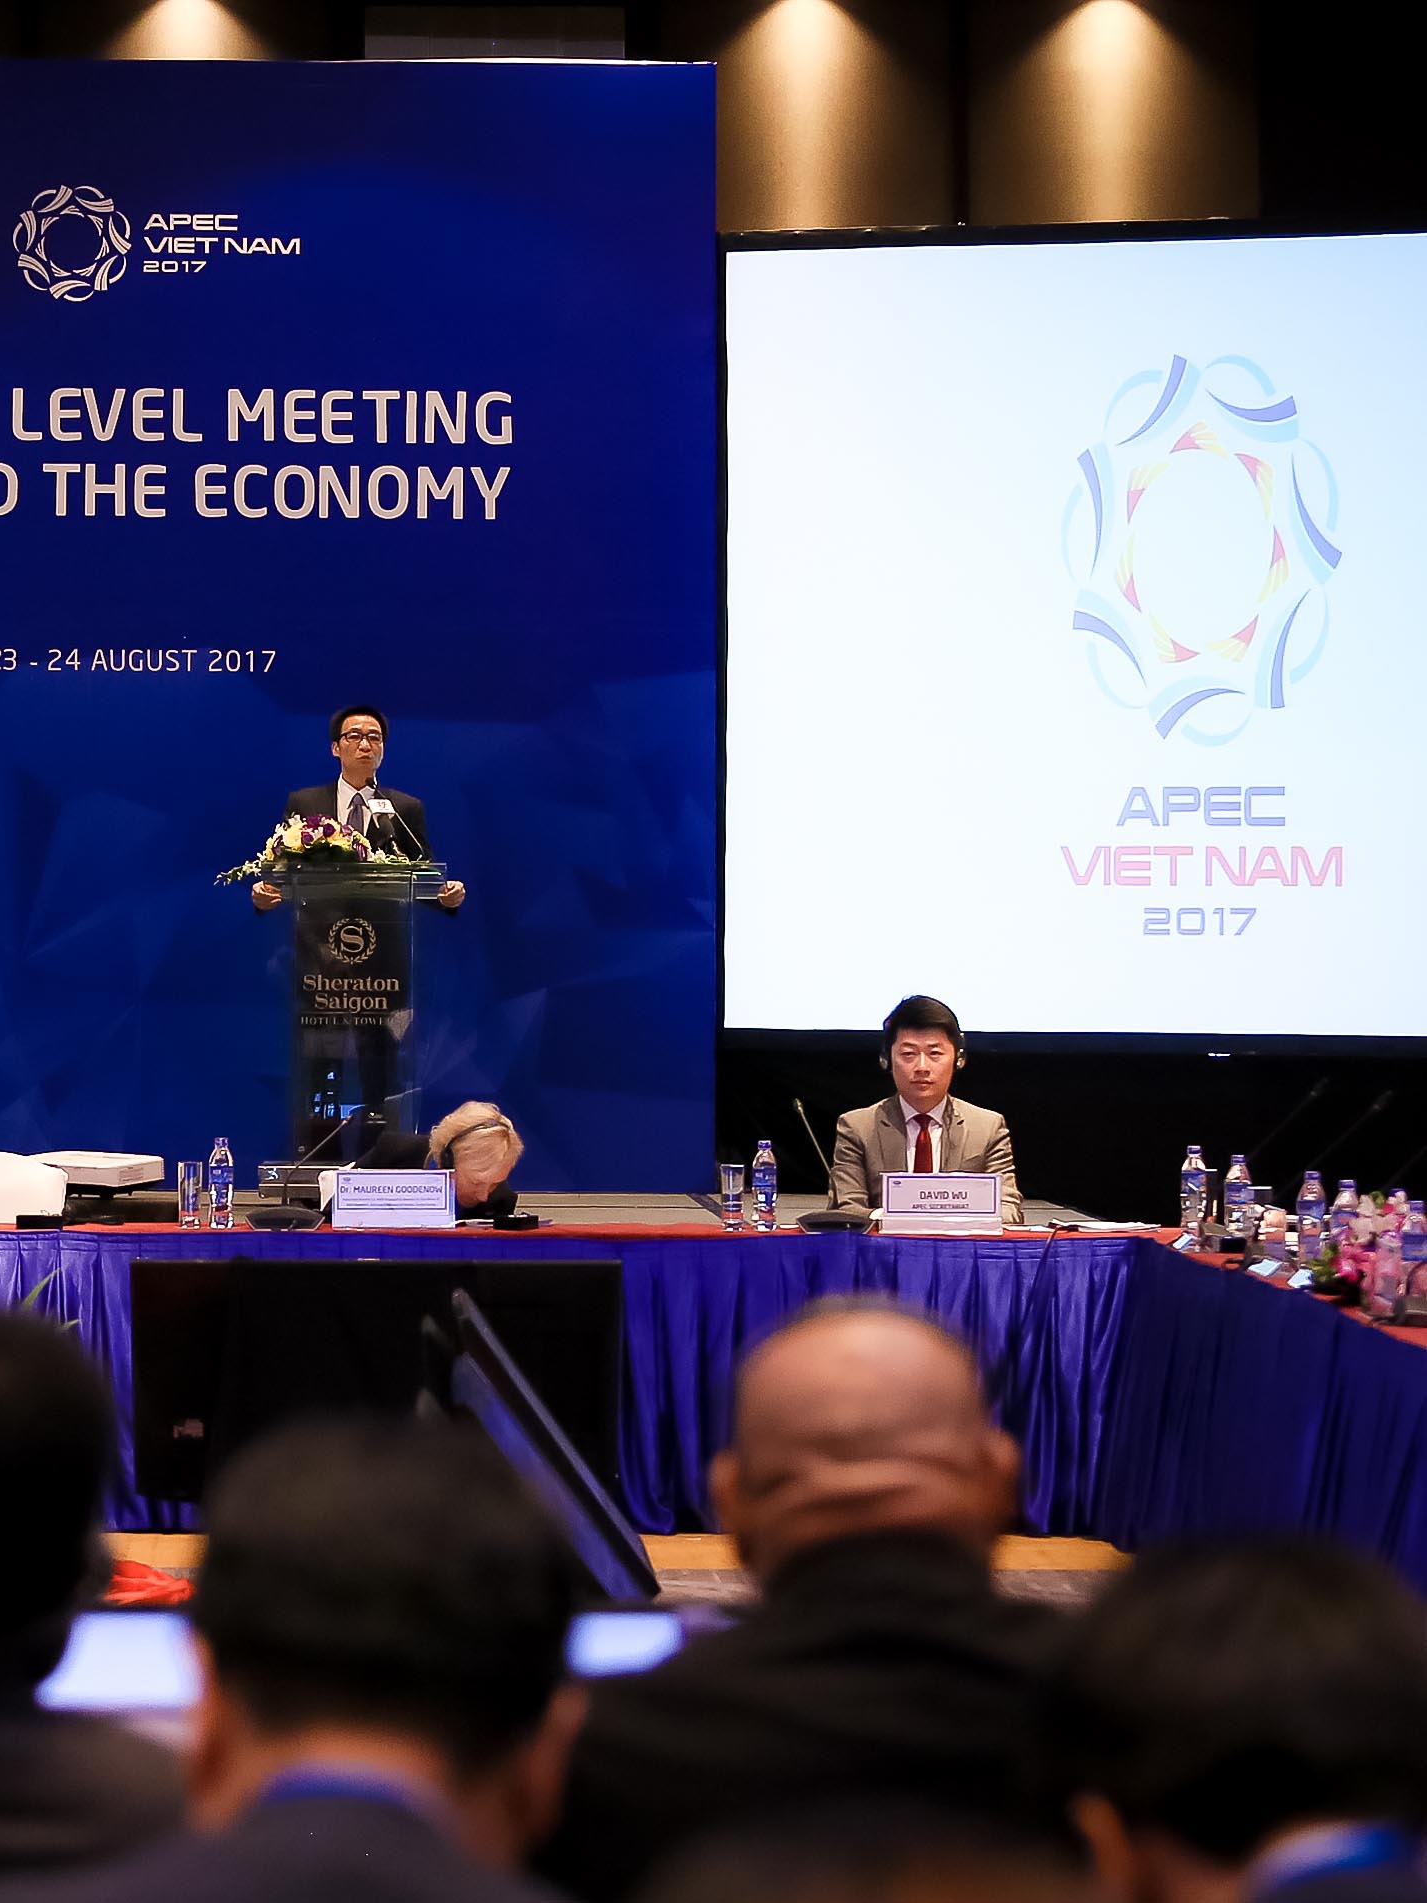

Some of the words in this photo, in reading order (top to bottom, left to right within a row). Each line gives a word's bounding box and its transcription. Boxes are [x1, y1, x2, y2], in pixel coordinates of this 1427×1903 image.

[143, 213, 239, 232] APEC
[143, 236, 218, 254] VIET
[225, 237, 301, 255] NAM
[142, 260, 207, 273] 2017
[13, 388, 203, 443] LEVEL
[228, 389, 513, 445] MEETING
[43, 464, 167, 517] THE
[194, 464, 511, 522] ECONOMY
[47, 649, 81, 671] 24
[92, 649, 198, 672] AUGUST
[208, 650, 277, 673] 2017
[1116, 786, 1286, 828] APEC
[1060, 845, 1194, 887] VIET
[1205, 845, 1344, 888] NAM
[1142, 907, 1257, 937] 2017
[341, 926, 364, 952] S
[303, 974, 400, 991] Sheraton
[314, 992, 388, 1013] Saigon
[353, 1185, 393, 1194] MAUREEN
[395, 1185, 443, 1194] GOODENOW
[919, 1191, 949, 1199] DAVID
[952, 1191, 968, 1199] WU
